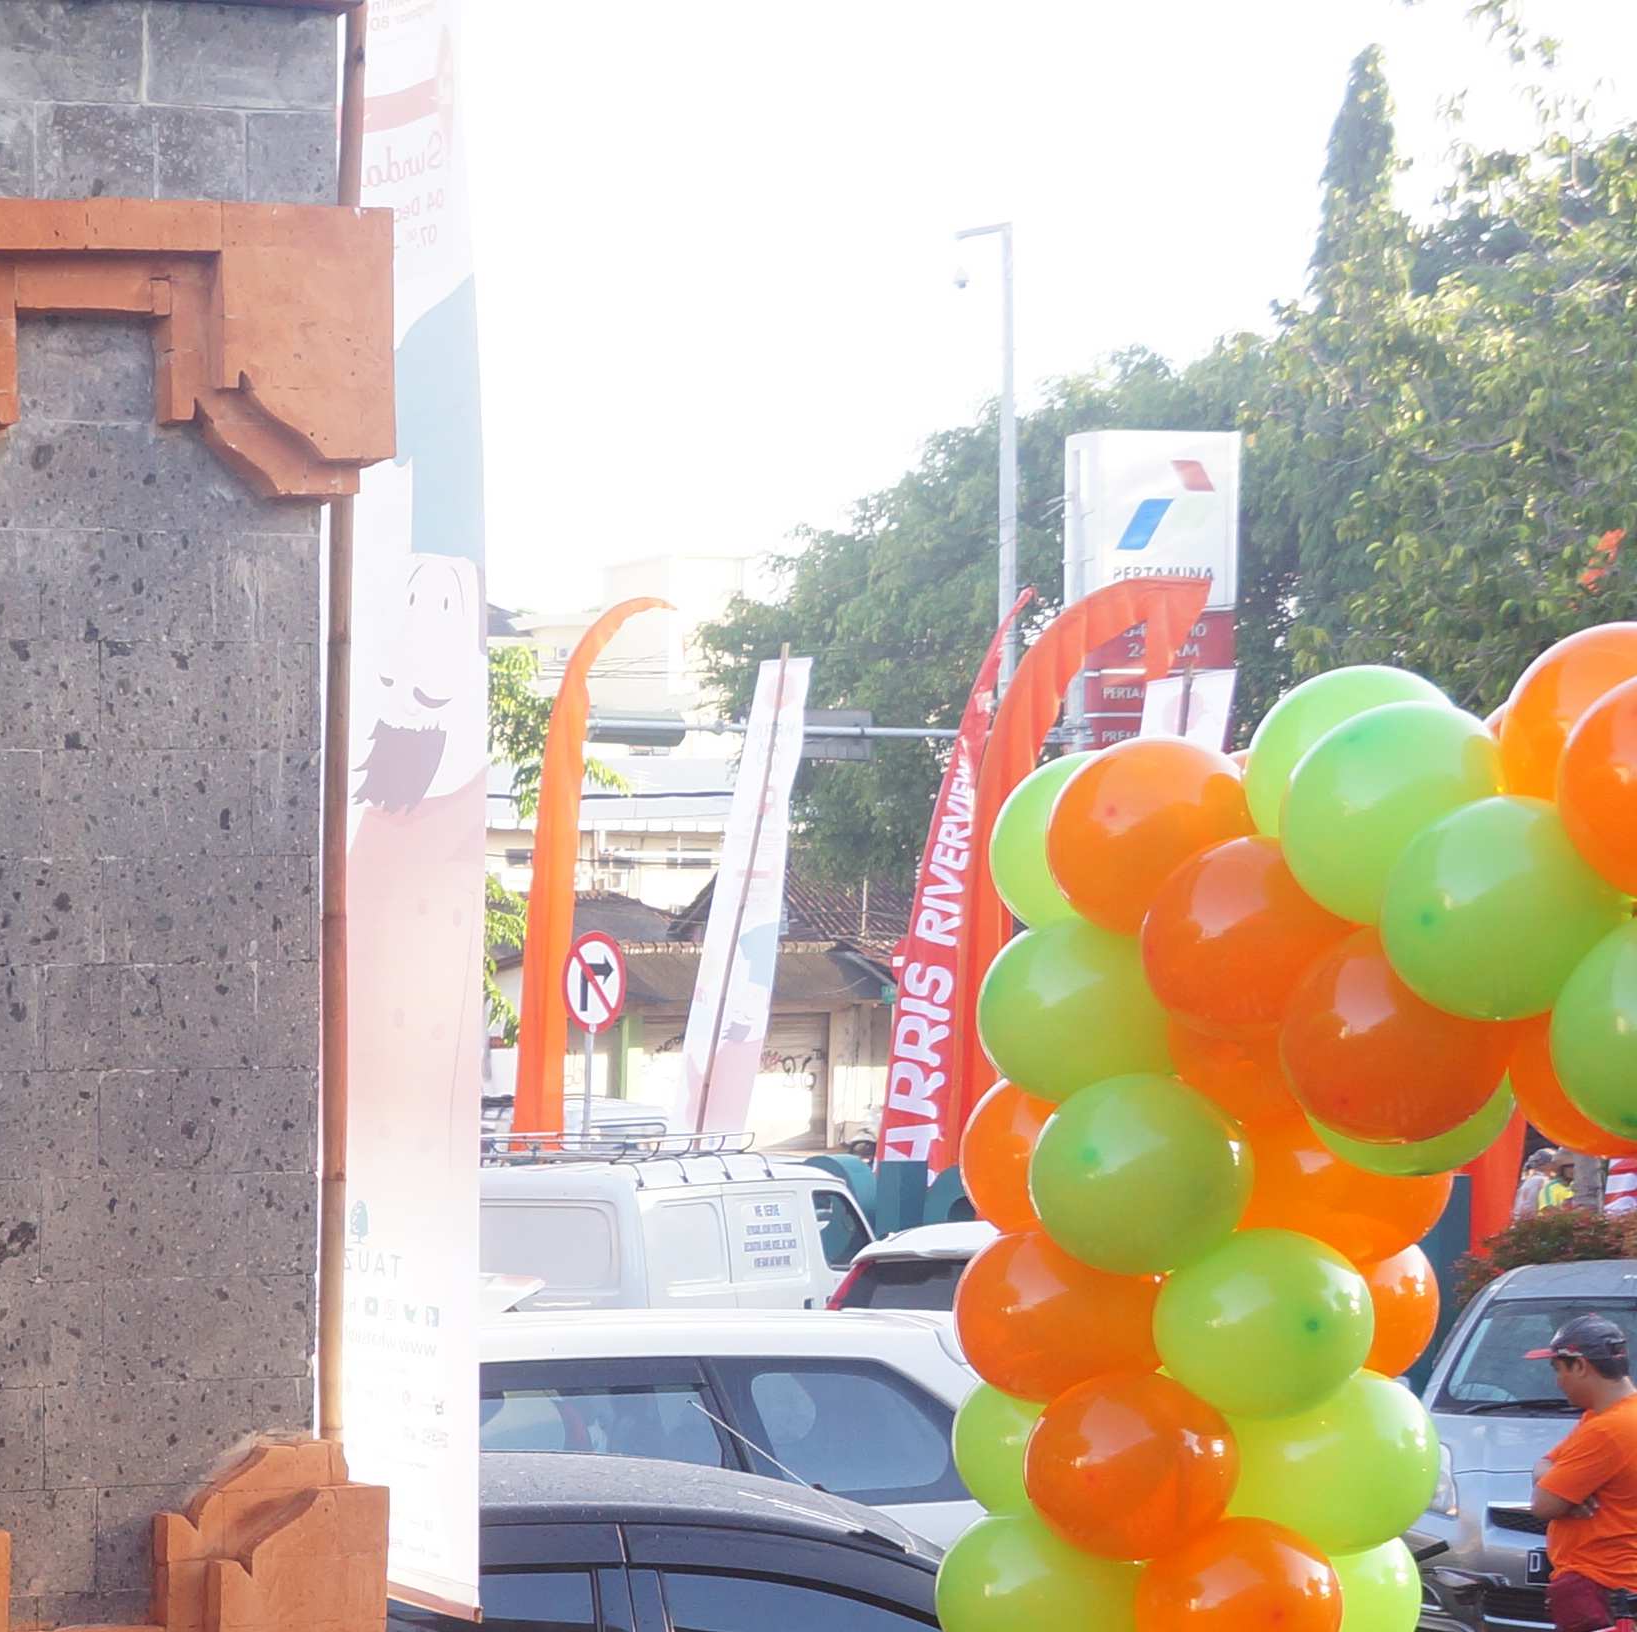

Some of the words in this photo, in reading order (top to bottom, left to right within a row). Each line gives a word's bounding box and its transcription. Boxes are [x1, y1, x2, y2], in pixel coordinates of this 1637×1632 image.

[1103, 687, 1144, 700] PERTA
[915, 757, 975, 948] RIVERVIEW
[883, 962, 955, 1162] ARRIS
